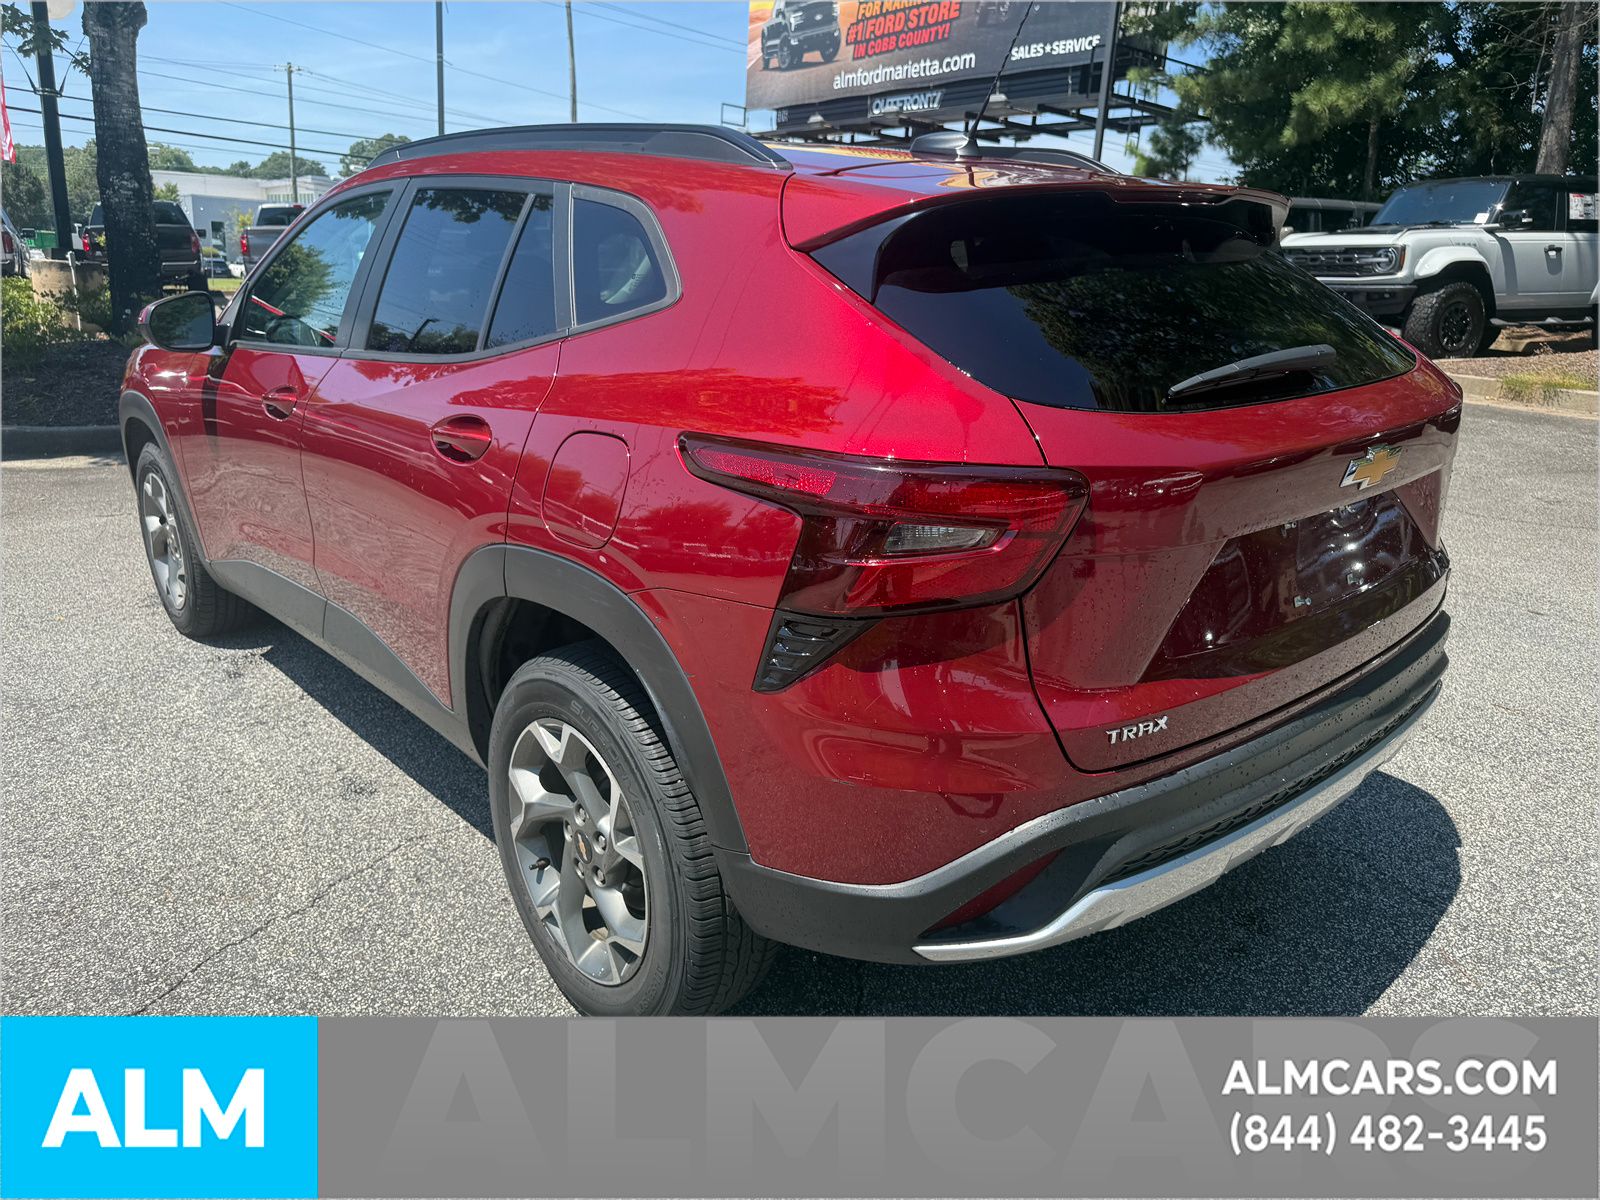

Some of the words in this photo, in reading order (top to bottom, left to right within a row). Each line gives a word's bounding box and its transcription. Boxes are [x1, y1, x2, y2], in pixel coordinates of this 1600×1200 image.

[847, 22, 864, 43] #1
[866, 12, 905, 39] FORD
[907, 1, 959, 29] STORE
[858, 1, 881, 19] FOR
[854, 42, 866, 58] IN
[868, 36, 897, 56] COBB
[898, 22, 950, 49] COUNTY!
[833, 52, 975, 89] almfordmarietta.com
[1106, 715, 1168, 744] TRAX
